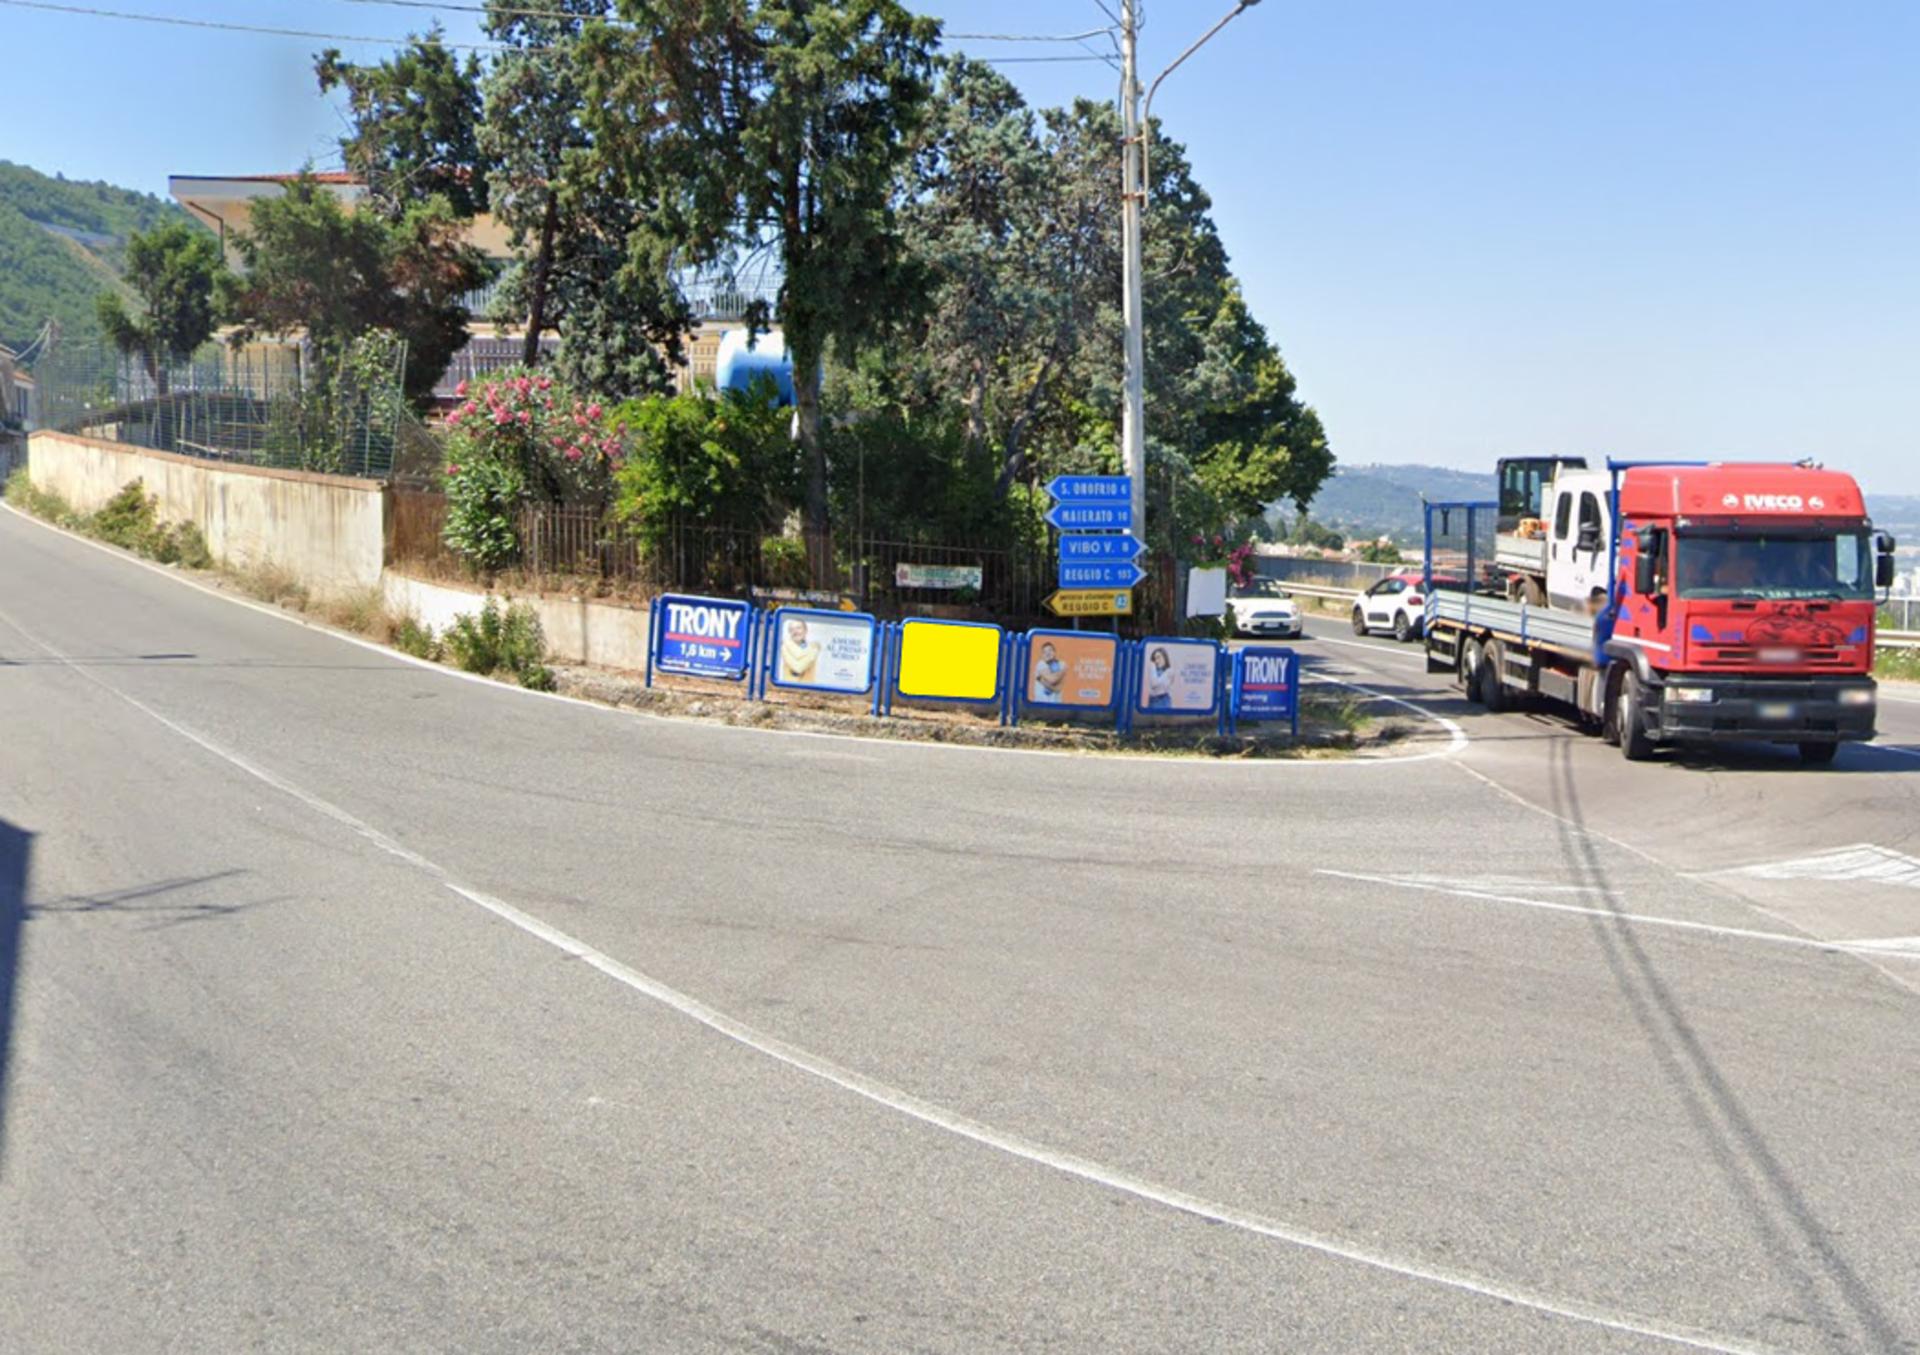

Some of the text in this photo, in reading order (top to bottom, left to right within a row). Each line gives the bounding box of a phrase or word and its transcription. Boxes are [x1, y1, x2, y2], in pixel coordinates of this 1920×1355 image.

[1061, 483, 1071, 495] S.
[1743, 494, 1804, 510] IVECO
[1062, 510, 1113, 522] MAIERATO
[1069, 541, 1100, 553] VIBO
[1065, 569, 1100, 581] REGGIO
[1062, 602, 1100, 611] REGGIO
[667, 603, 742, 639] TRONY
[699, 645, 717, 659] km
[1245, 656, 1289, 683] TRONY
